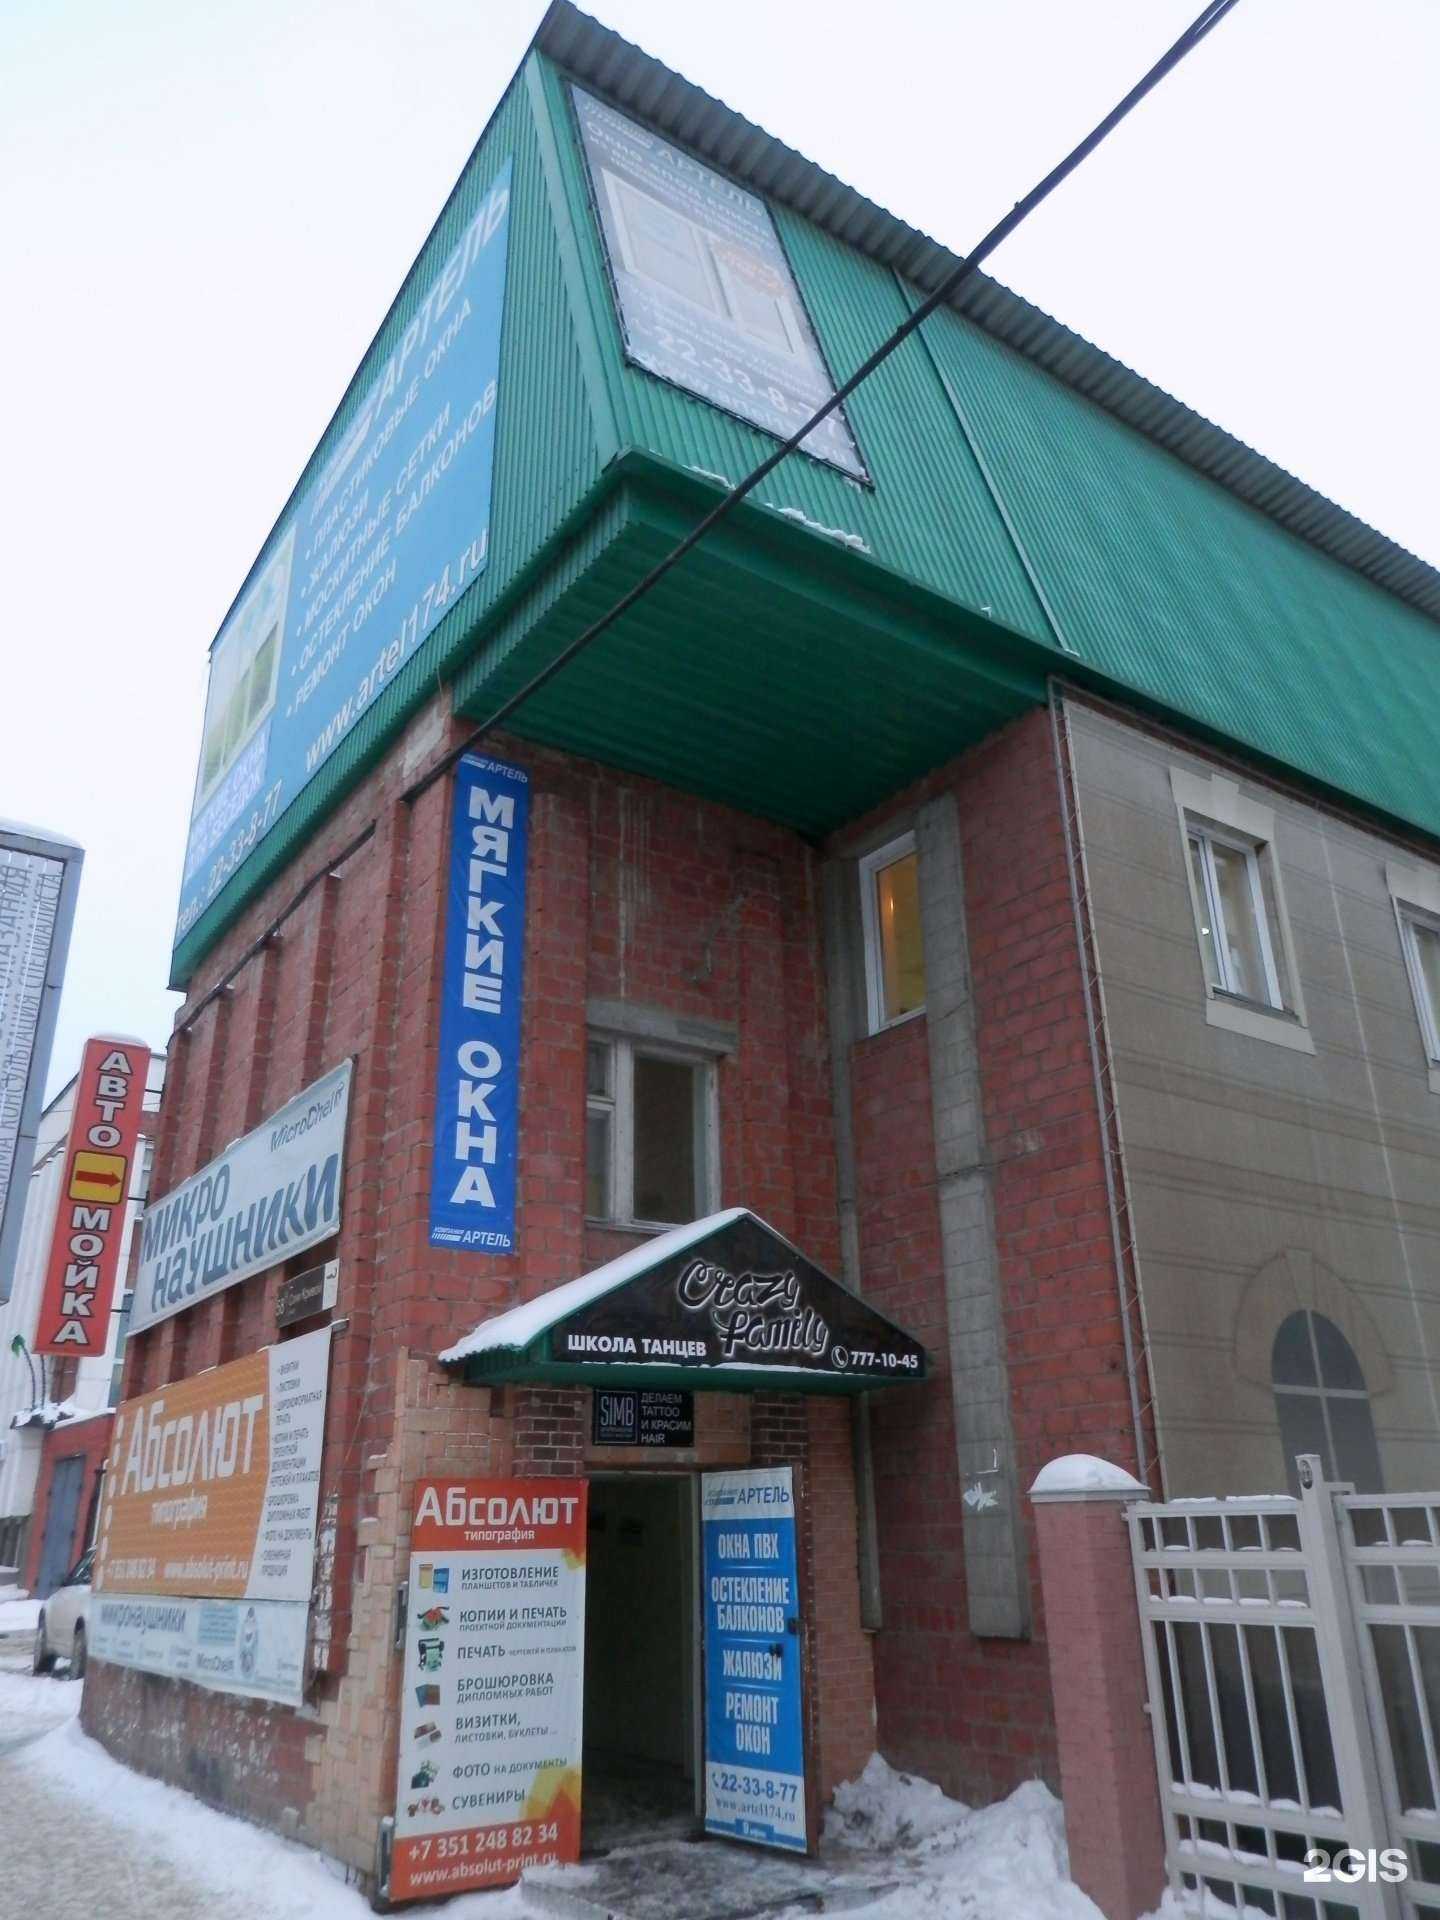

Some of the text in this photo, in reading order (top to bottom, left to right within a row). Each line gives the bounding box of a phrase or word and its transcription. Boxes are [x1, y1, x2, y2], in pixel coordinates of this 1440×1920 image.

[376, 188, 509, 420] АРТЕЛЬ
[314, 376, 421, 553] ПЛАСТИКОВЫЕ
[424, 298, 471, 380] ОКНА
[300, 527, 392, 670] ОСТЕКЛЕНИЕ
[396, 379, 496, 537] БАЛКОНОВ
[304, 489, 392, 632] МОСКИТНЫЕ
[396, 401, 450, 495] СЕТКИ
[309, 488, 369, 587] ЖАЛЮЗИ
[295, 559, 396, 713] РЕМОНТ ОКОН
[306, 530, 488, 773] www.artel174.ru
[487, 762, 528, 784] АРТЕЛЬ
[207, 779, 282, 899] 22-33-8-77
[463, 786, 514, 1015] МЯГКИЕ
[449, 1040, 502, 1208] ОКНА
[53, 1050, 132, 1346] АВТО МОЙКА
[462, 1230, 511, 1248] АРТЕЛЬ
[677, 1258, 801, 1311] Crazy
[568, 1334, 707, 1359] ШКОЛА ТАНЦЕВ
[850, 1351, 918, 1369] 777-10-45
[600, 1395, 634, 1427] SIMB
[641, 1392, 682, 1403] ДЕЛАЕМ
[641, 1420, 691, 1431] И КРАСИМ
[737, 1486, 790, 1504] АРТЕЛЬ
[464, 1527, 535, 1543] типография
[718, 1533, 779, 1558] ОКНА ПВХ
[461, 1581, 512, 1591] ПЛАНШЕТОВ
[519, 1579, 558, 1588] ТАБЛИЧЕК
[462, 1566, 559, 1580] ИЗГОТОВЛЕНИЕ
[711, 1577, 789, 1604] ОСТЕКЛЕНИЕ
[459, 1620, 567, 1632] ПРОЕКТНОЙ ДОКУМЕНТАЦИИ
[460, 1606, 568, 1623] КОПИИ И ПЕЧАТЬ
[717, 1606, 784, 1633] БАЛКОНОВ
[457, 1644, 505, 1659] ПЕЧАТЬ
[723, 1650, 782, 1681] ЖАЛЮЗИ
[457, 1673, 554, 1692] БРОШЮРОВКА
[457, 1686, 554, 1704] ДИПЛОМНЫХ РАБОТ
[456, 1712, 521, 1730] ВИЗИТКИ,
[725, 1692, 779, 1724] РЕМОНТ
[736, 1723, 770, 1755] ОКОН
[452, 1758, 568, 1779] ФОТО НА ДОКУМЕНТЫ
[452, 1790, 526, 1810] СУВЕНИРЫ
[721, 1772, 798, 1803] 22-33-8-77
[409, 1822, 559, 1861] +7 351 248 82 34
[410, 1852, 556, 1886] www.absolut-printru
